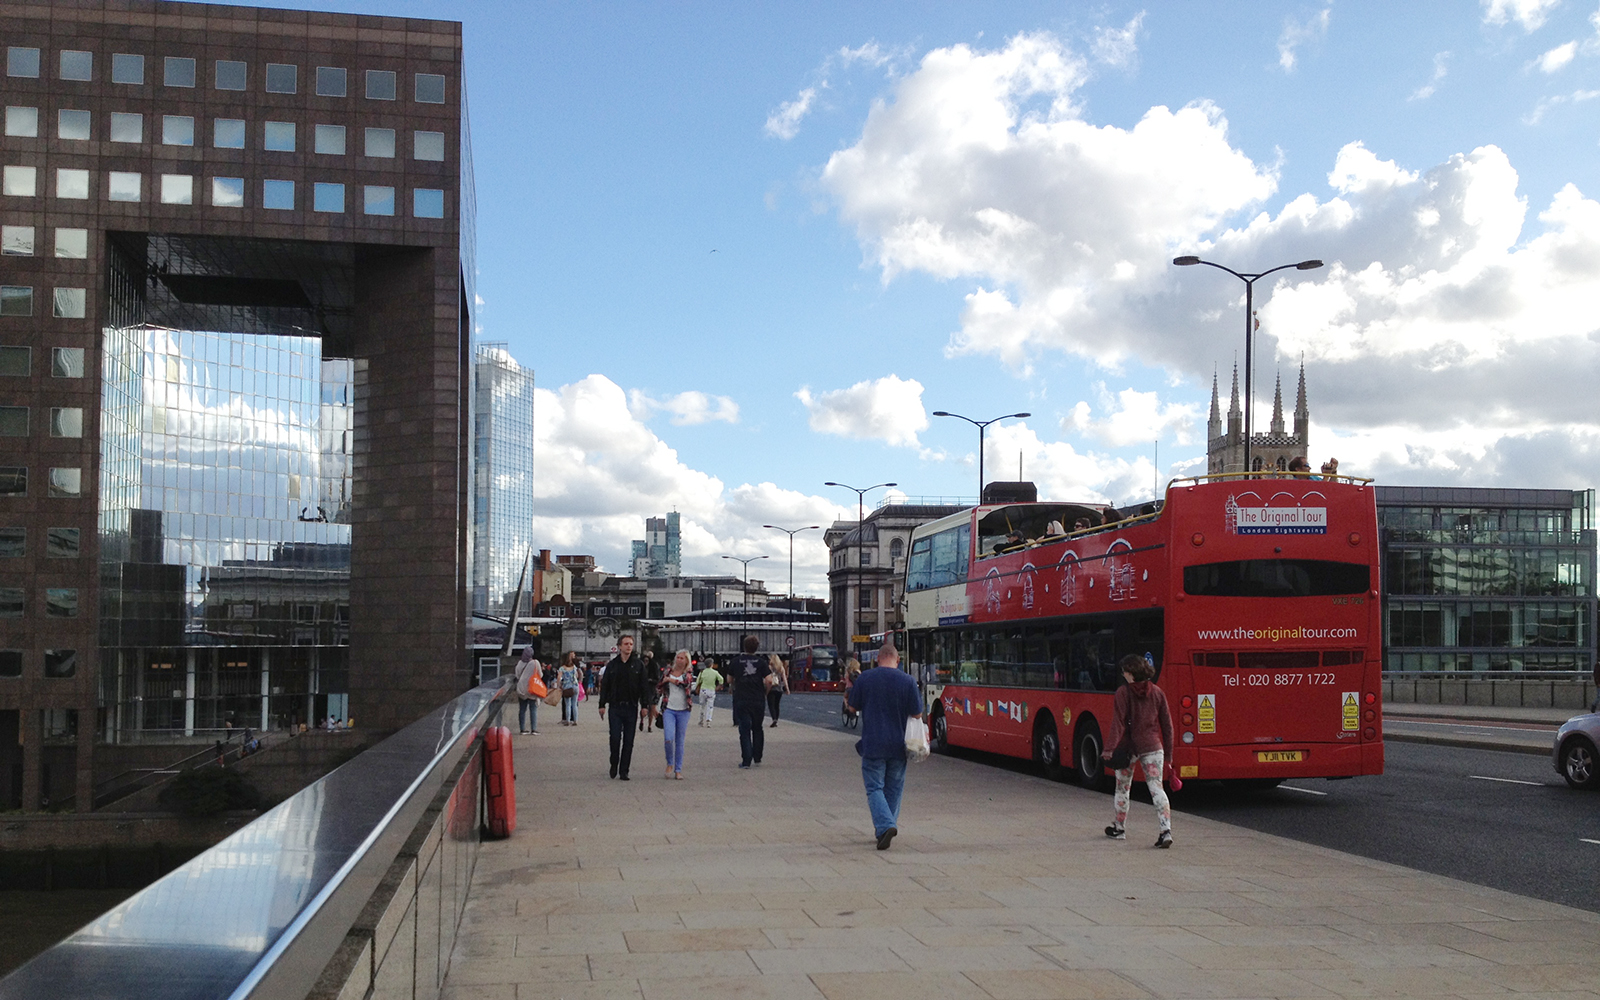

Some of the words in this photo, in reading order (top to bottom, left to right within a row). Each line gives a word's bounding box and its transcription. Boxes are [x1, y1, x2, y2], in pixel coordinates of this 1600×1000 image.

[1241, 508, 1257, 522] The
[1261, 508, 1299, 526] Original
[1302, 508, 1322, 522] Tour
[1198, 626, 1357, 642] www.theoriginaltour.com
[1248, 674, 1270, 686] 020
[1274, 673, 1303, 685] 8877
[1307, 673, 1336, 685] 1722
[1264, 752, 1279, 760] YJ11
[1280, 752, 1296, 760] TVK
